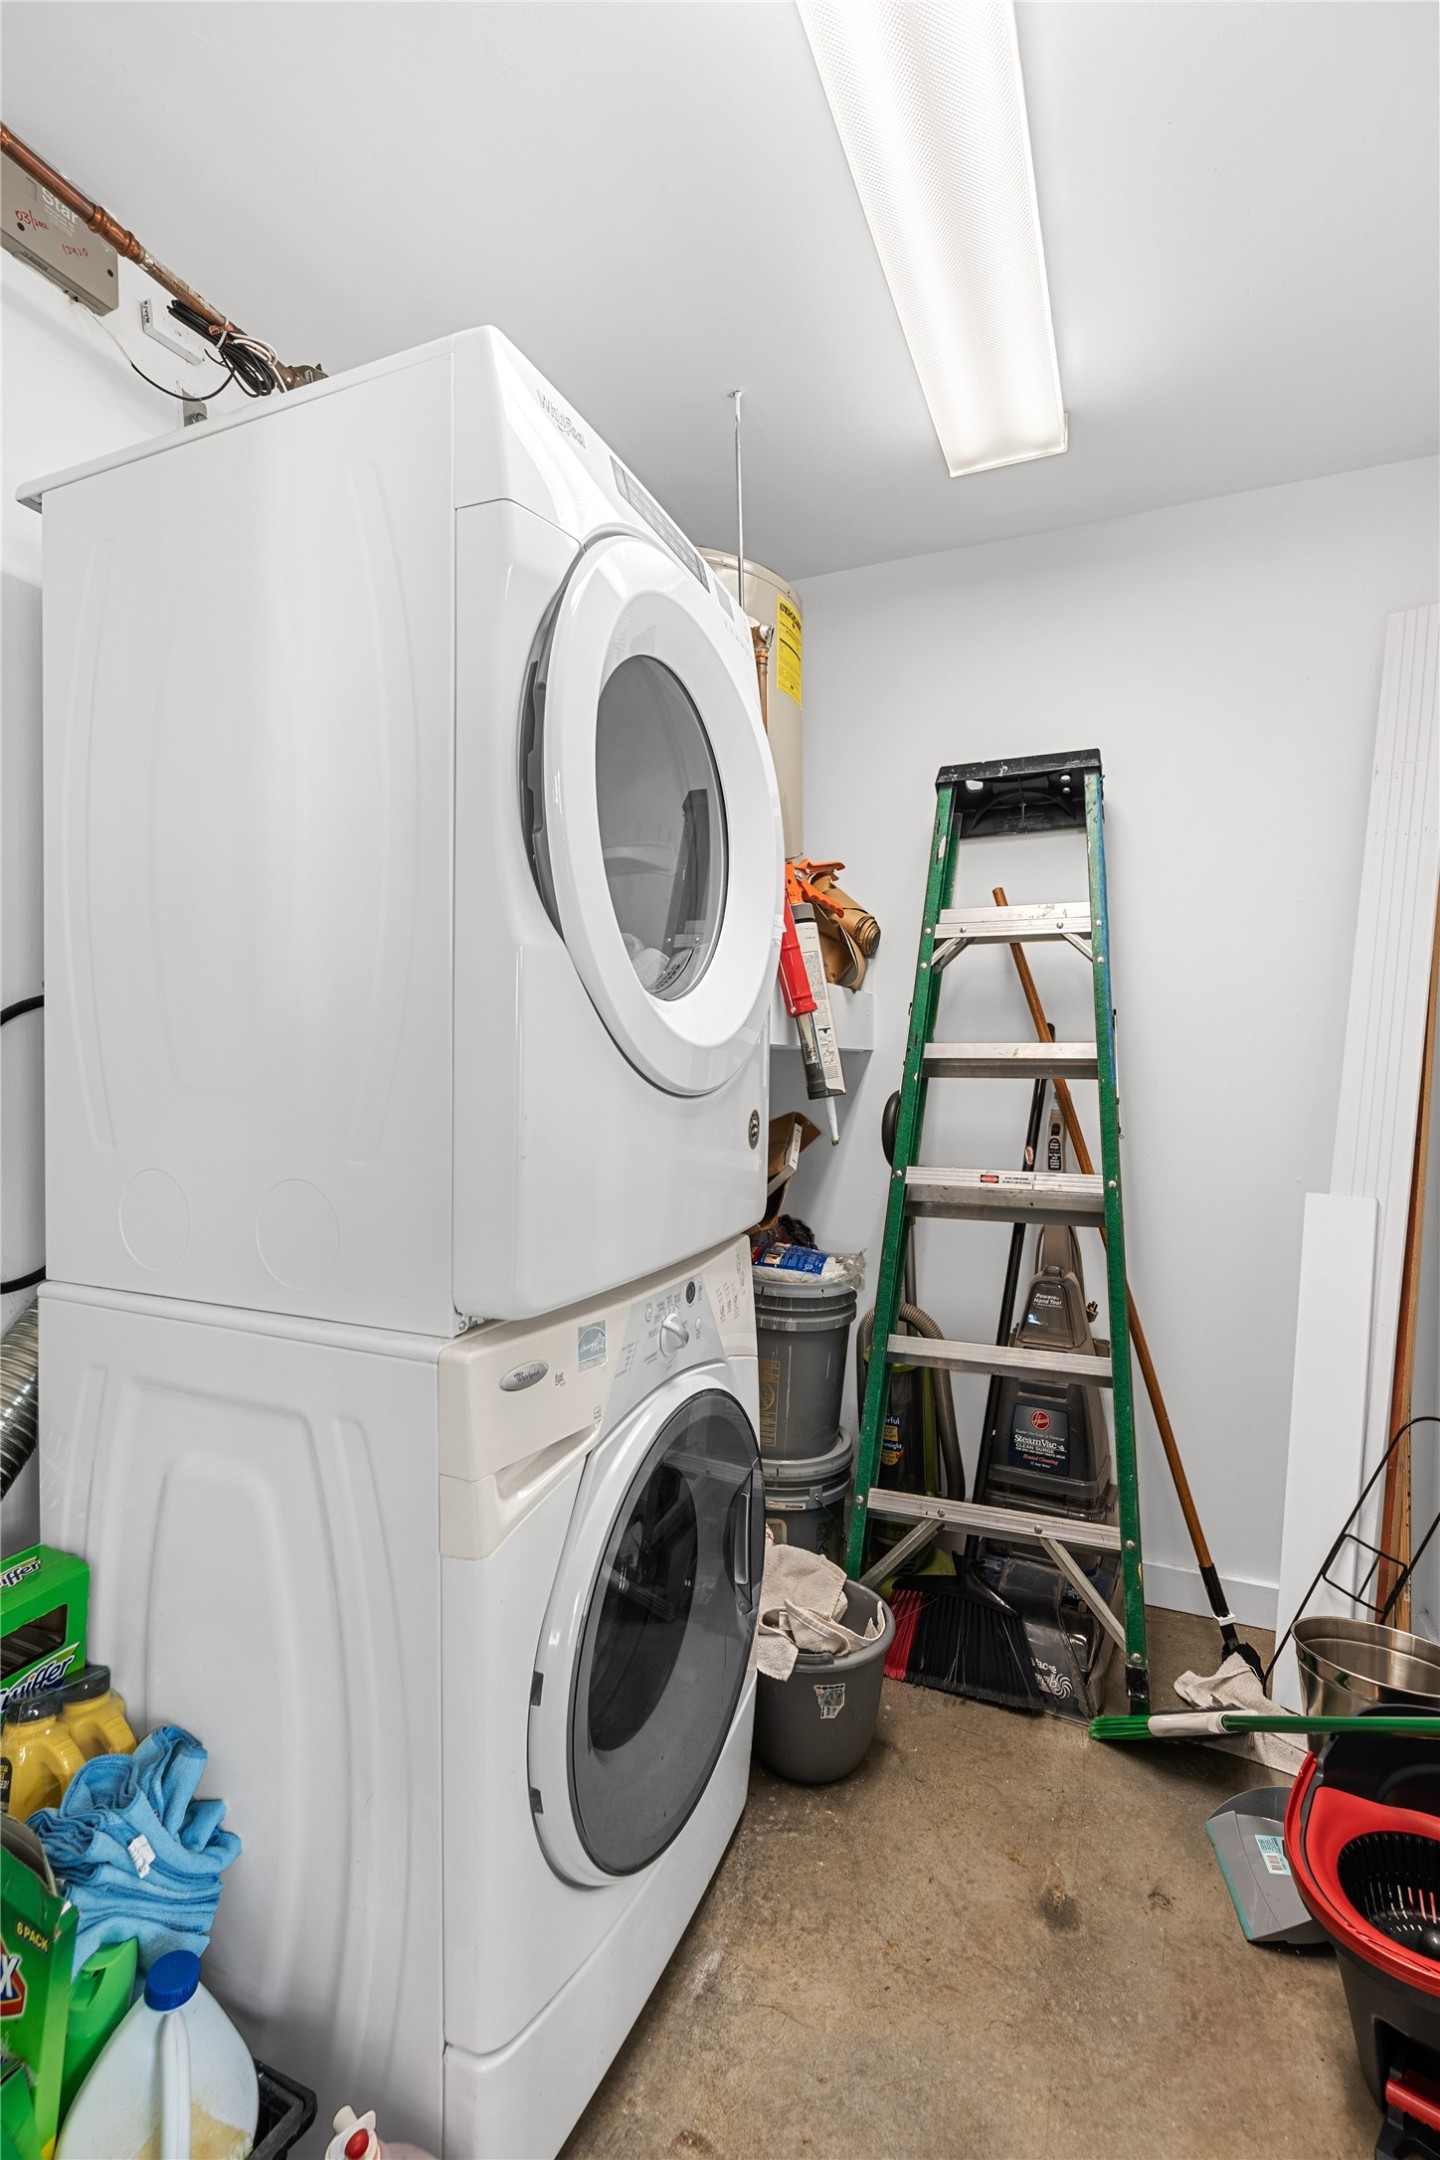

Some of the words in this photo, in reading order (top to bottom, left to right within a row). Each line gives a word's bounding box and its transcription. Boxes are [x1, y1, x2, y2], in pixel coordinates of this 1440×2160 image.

[41, 187, 78, 223] Star
[1014, 1434, 1057, 1449] SteamVac
[24, 1926, 48, 1952] PACK
